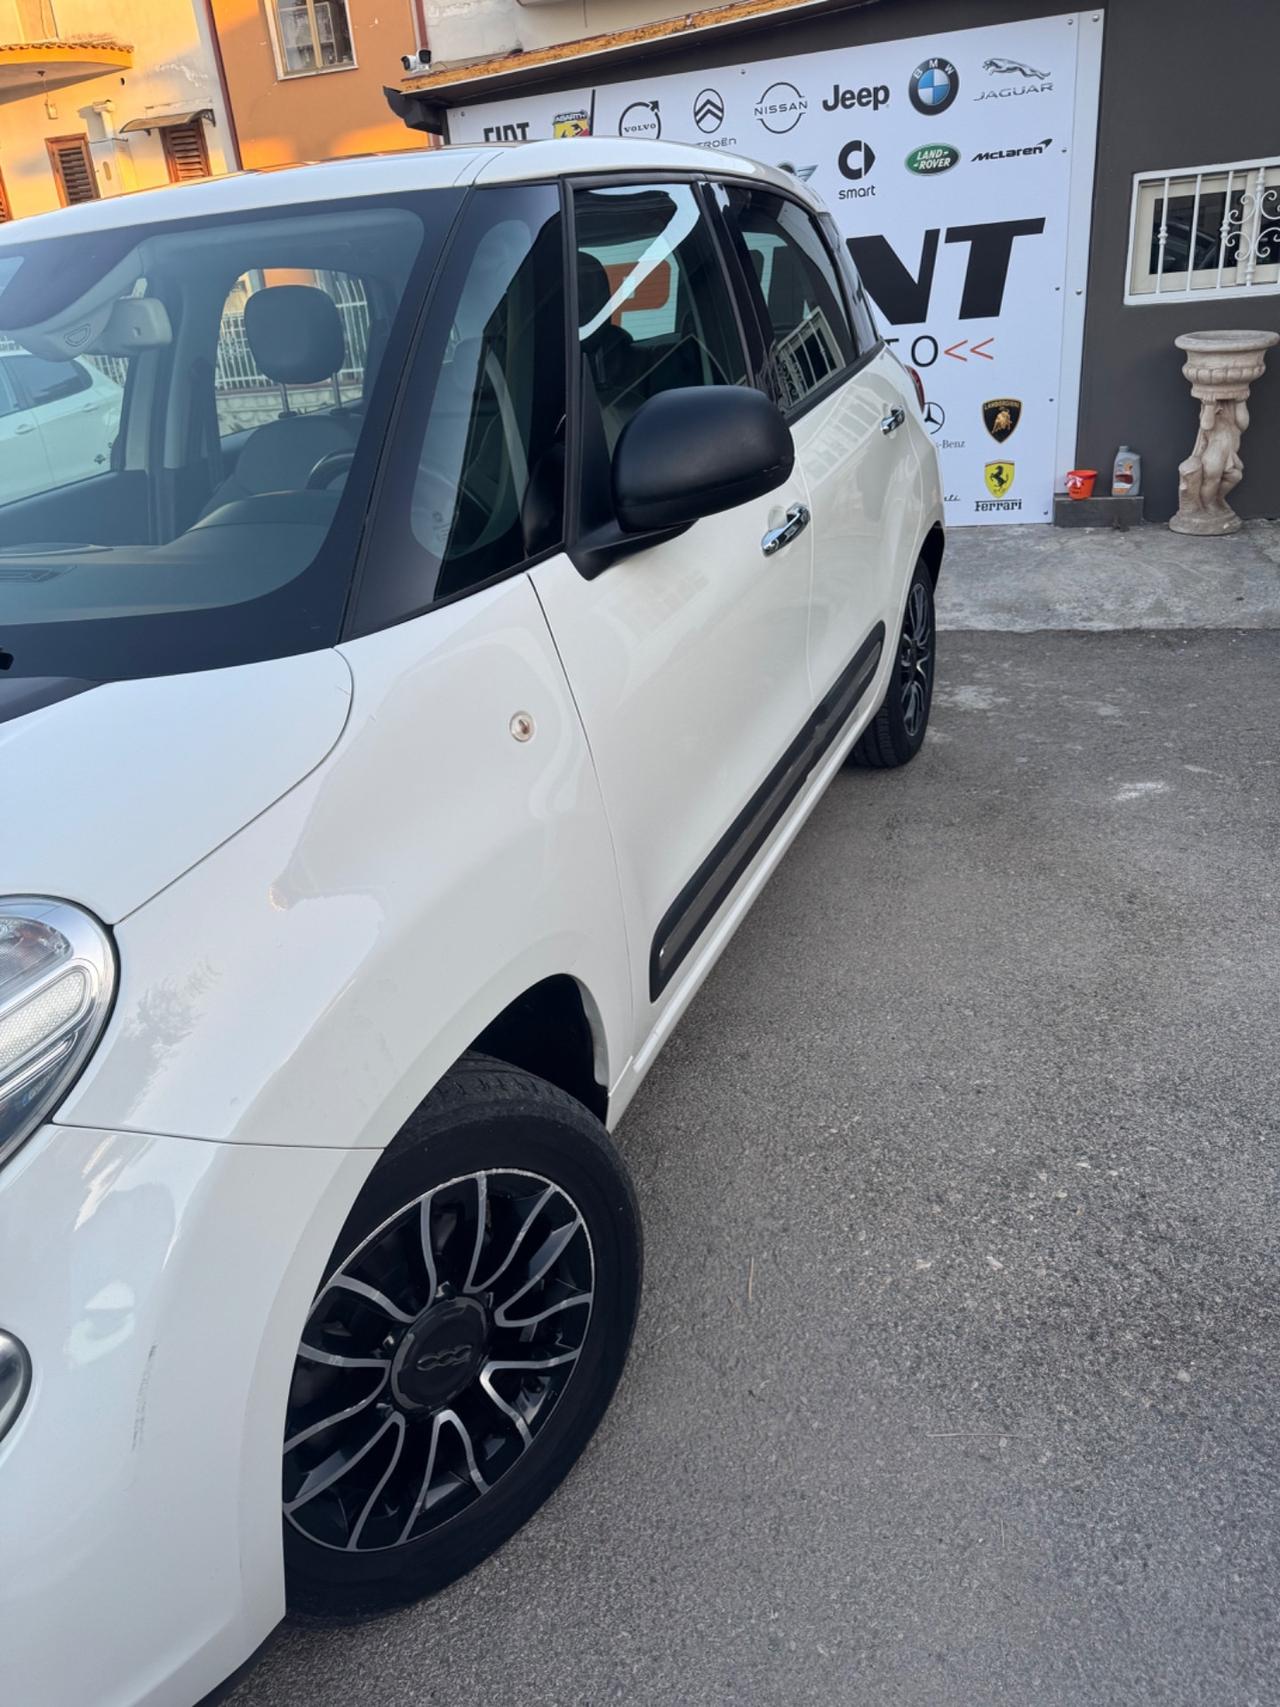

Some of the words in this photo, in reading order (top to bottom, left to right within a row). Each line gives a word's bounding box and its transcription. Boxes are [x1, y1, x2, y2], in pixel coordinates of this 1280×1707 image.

[912, 59, 955, 79] BMW
[822, 84, 890, 112] Jeep
[973, 82, 1054, 101] JAGUAR
[754, 100, 808, 116] NISSAN
[624, 123, 657, 133] VOLVO
[917, 150, 942, 160] LAND
[919, 158, 951, 170] ROVER
[838, 185, 876, 200] smart
[975, 499, 1022, 512] Ferrari
